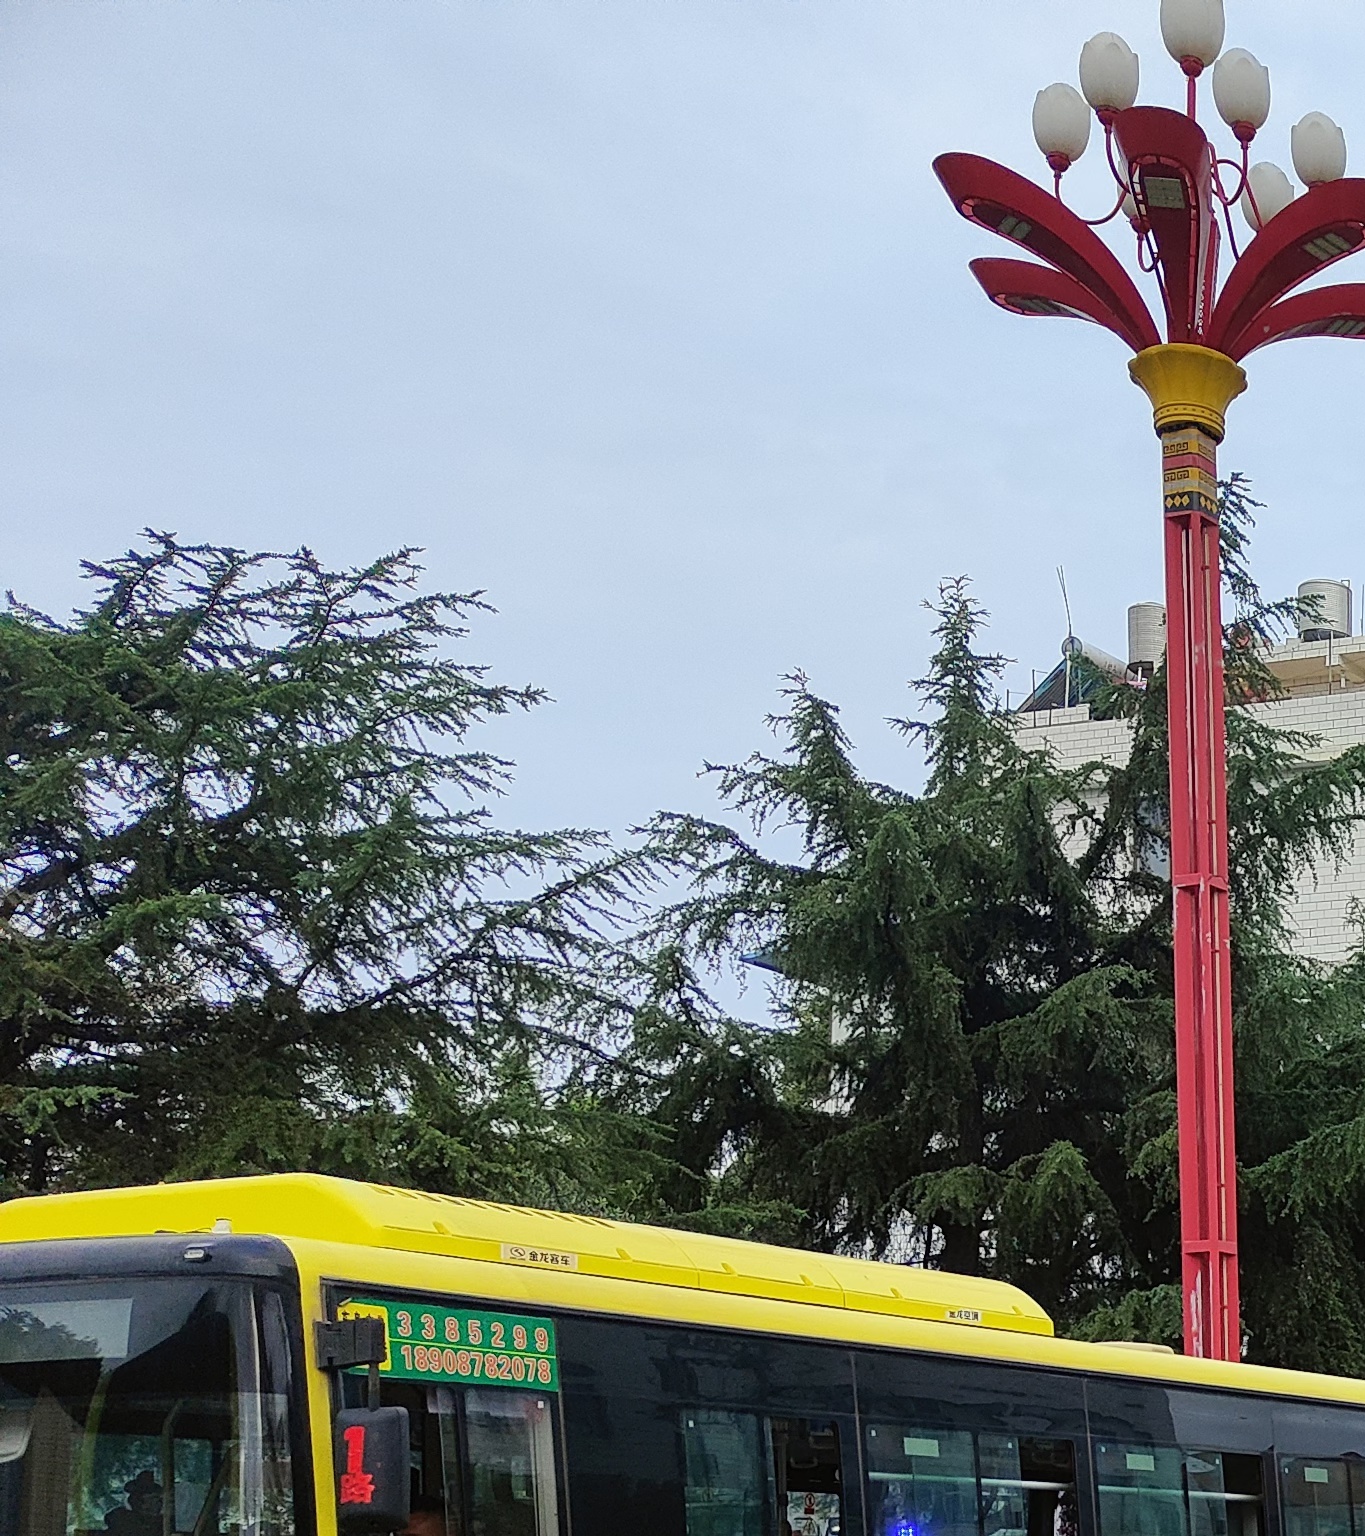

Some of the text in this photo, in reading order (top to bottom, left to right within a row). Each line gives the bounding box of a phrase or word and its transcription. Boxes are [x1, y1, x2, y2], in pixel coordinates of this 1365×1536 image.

[528, 1250, 571, 1266] 金龙客车
[397, 1311, 549, 1352] 3385299
[401, 1344, 551, 1384] 18908782078
